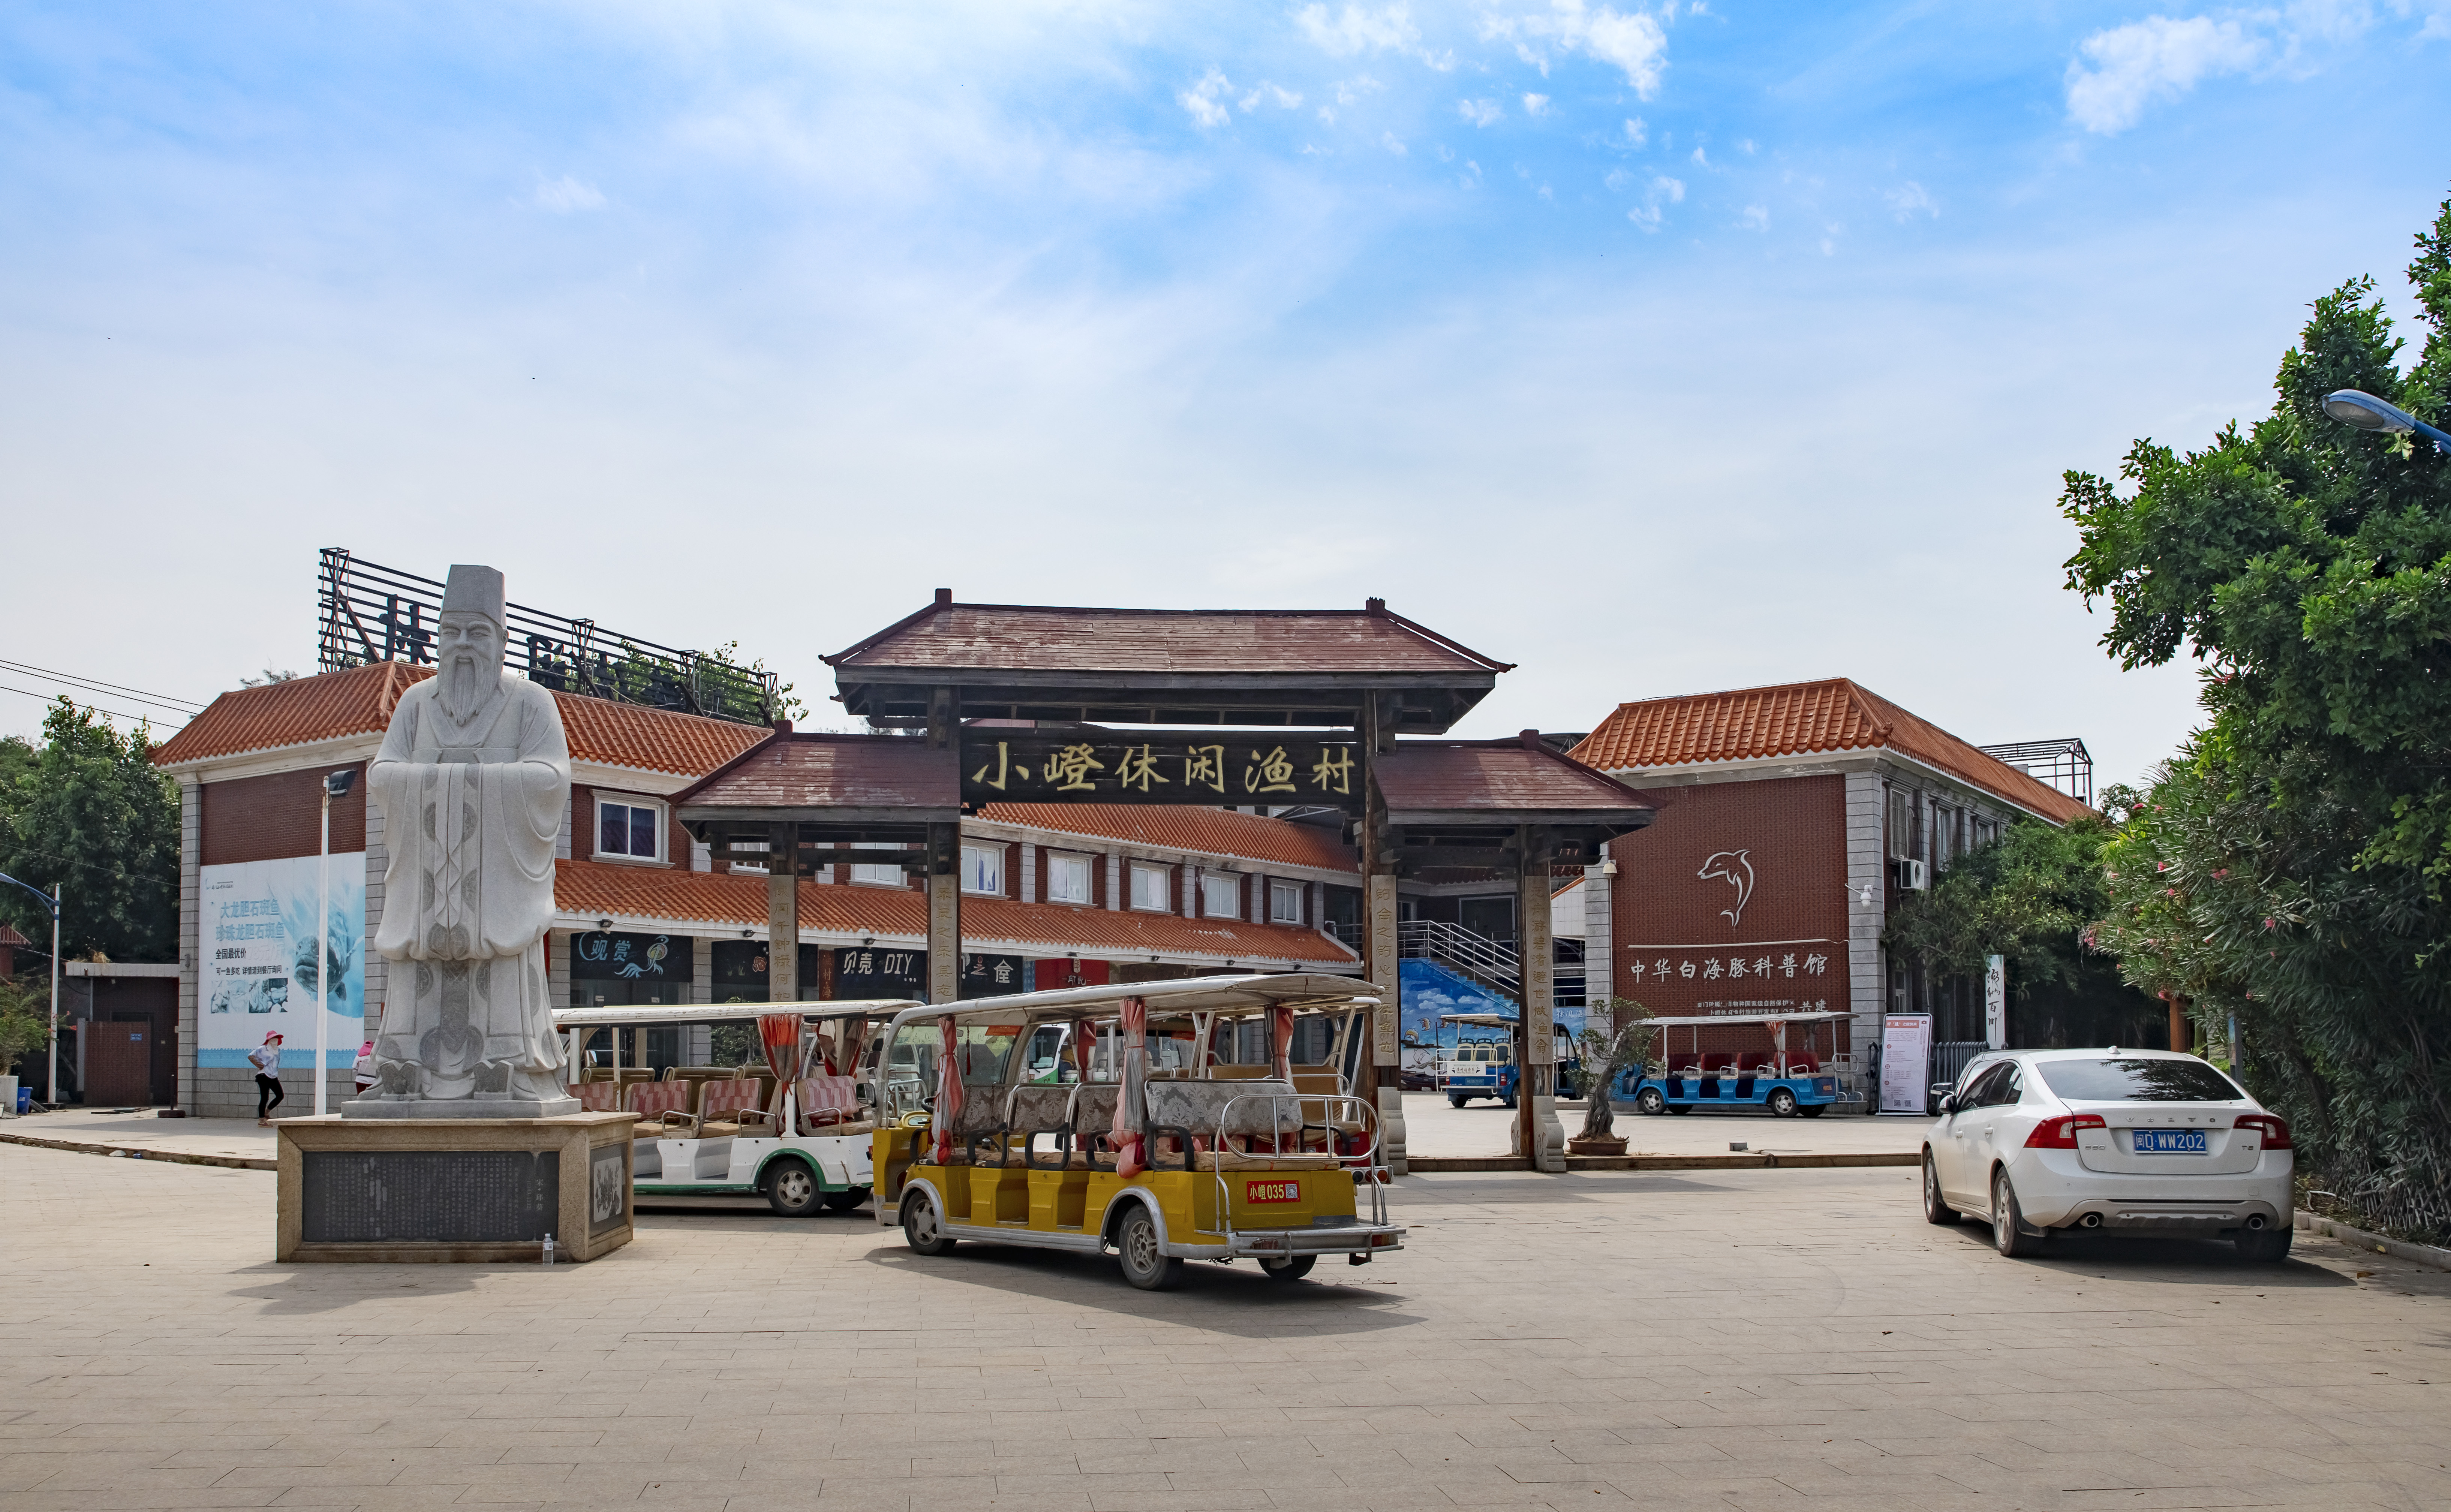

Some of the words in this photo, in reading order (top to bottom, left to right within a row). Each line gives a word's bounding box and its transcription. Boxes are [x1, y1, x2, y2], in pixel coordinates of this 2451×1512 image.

[972, 742, 1354, 794] 小嶝休闲渔村
[220, 899, 279, 918] 大龙胆石斑鱼
[216, 921, 285, 942] 珍珠龙胆石斑鱼
[216, 948, 246, 959] 全国最优价
[591, 940, 631, 962] 观赏
[216, 967, 240, 975] 可一鱼多吃
[242, 965, 282, 975] 详情请到餐厅询问
[843, 951, 873, 974] 贝壳
[884, 954, 913, 974] DIY
[1631, 953, 1828, 983] 中华白海豚科普馆
[1799, 999, 1828, 1012] 共建
